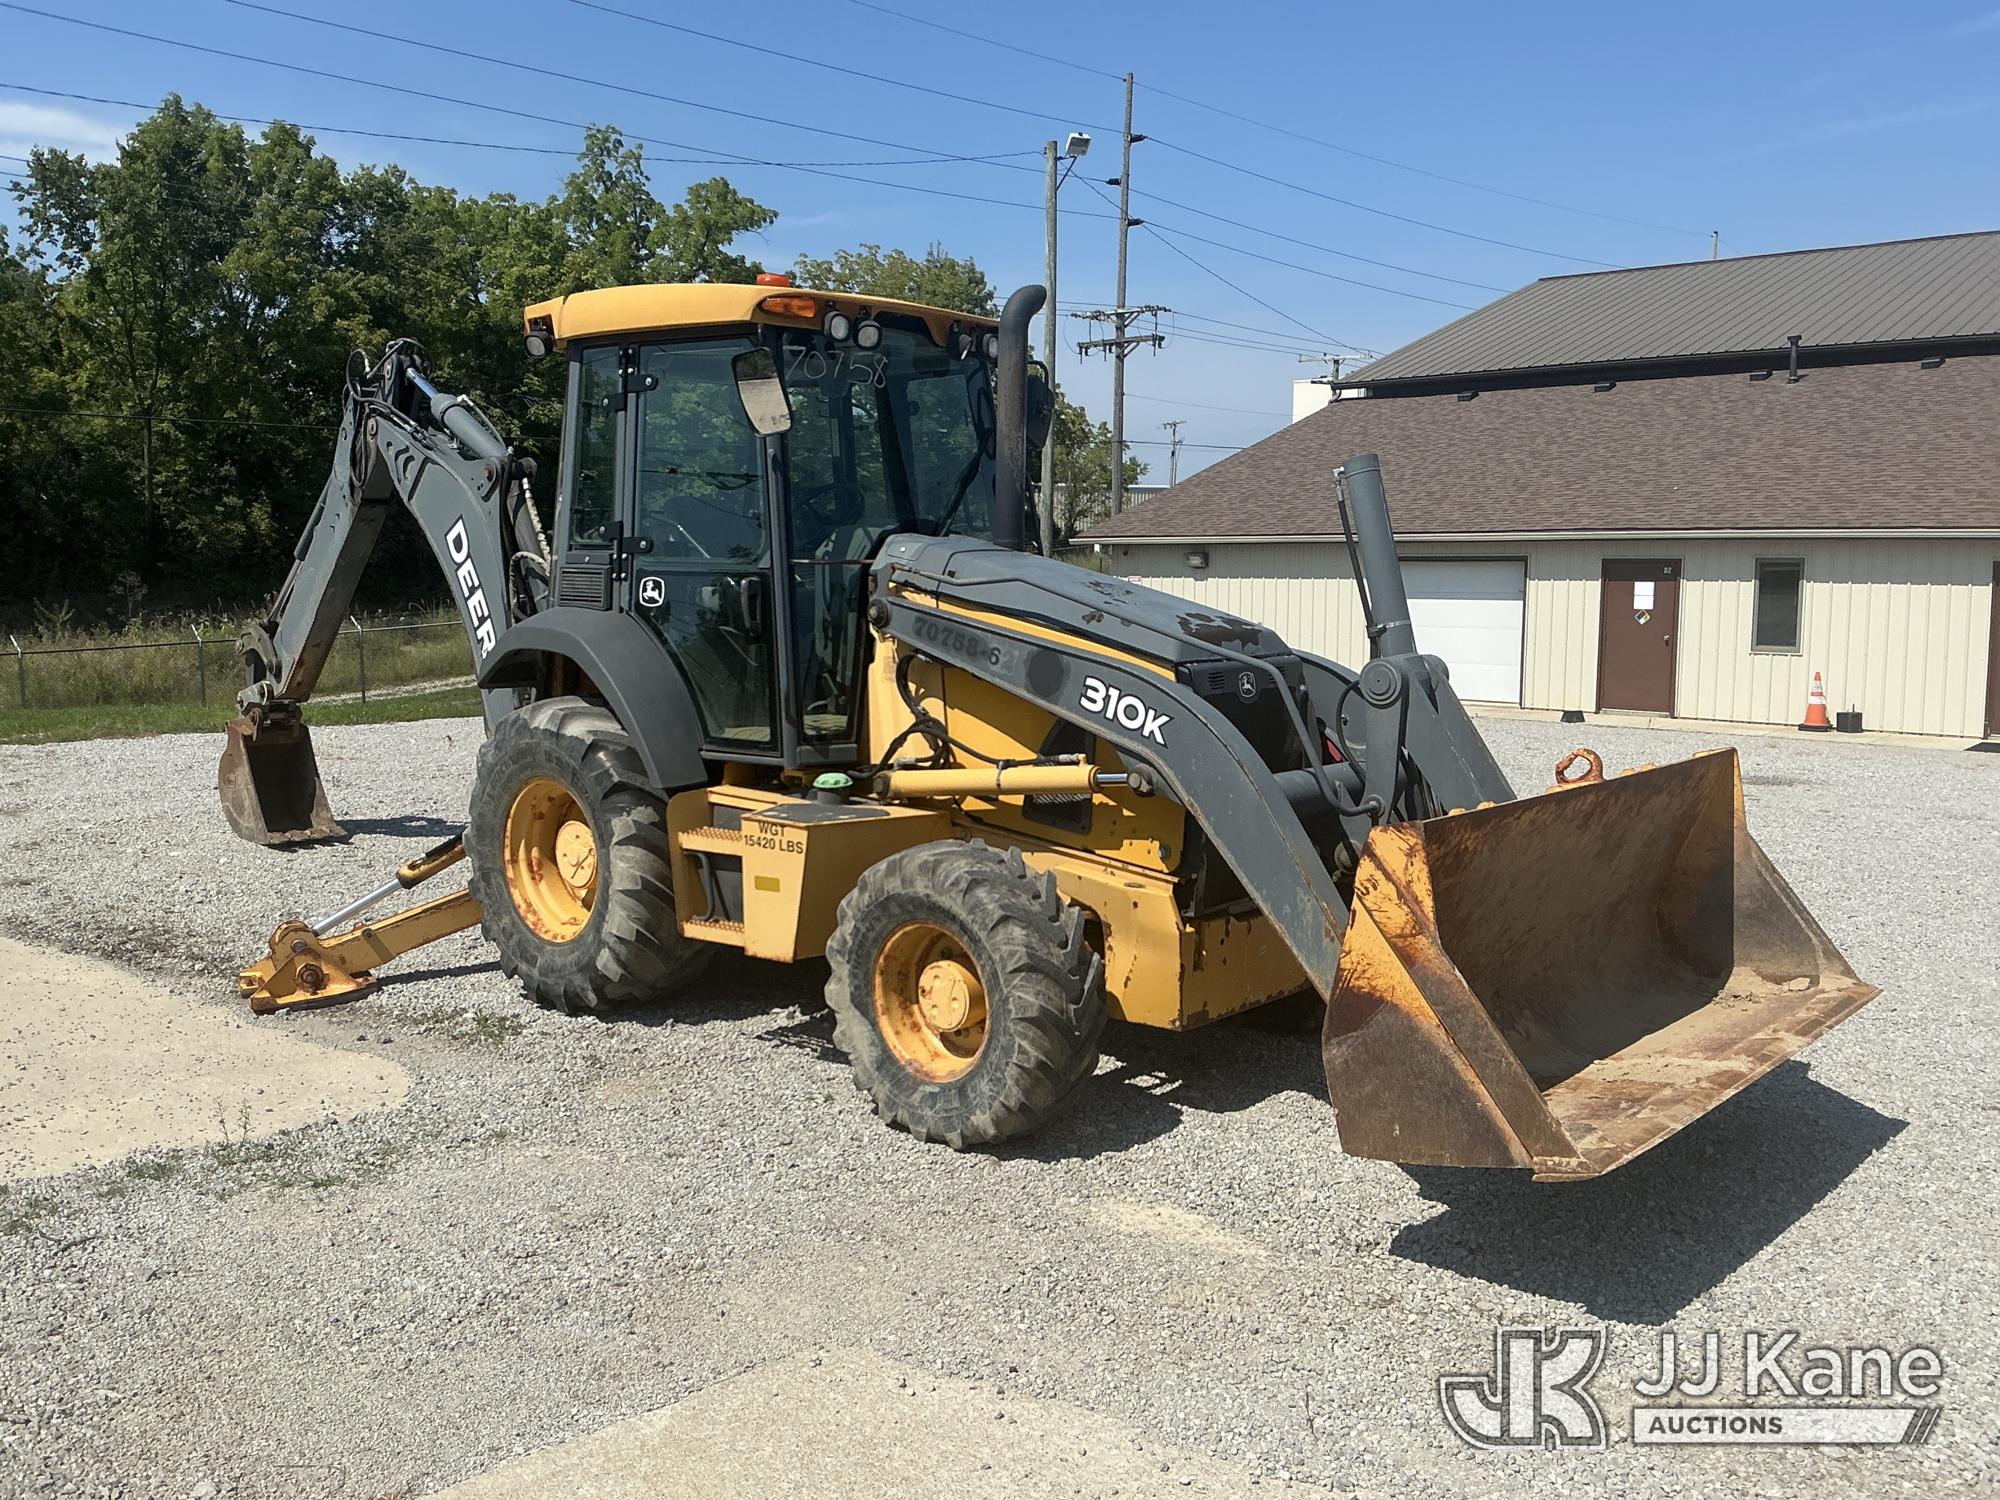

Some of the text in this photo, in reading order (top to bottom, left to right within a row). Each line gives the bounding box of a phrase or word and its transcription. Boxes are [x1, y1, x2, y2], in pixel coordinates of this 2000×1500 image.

[783, 345, 889, 389] 70758
[1079, 675, 1174, 747] 310K
[744, 834, 804, 854] 15420 LBS
[759, 822, 786, 837] WGT
